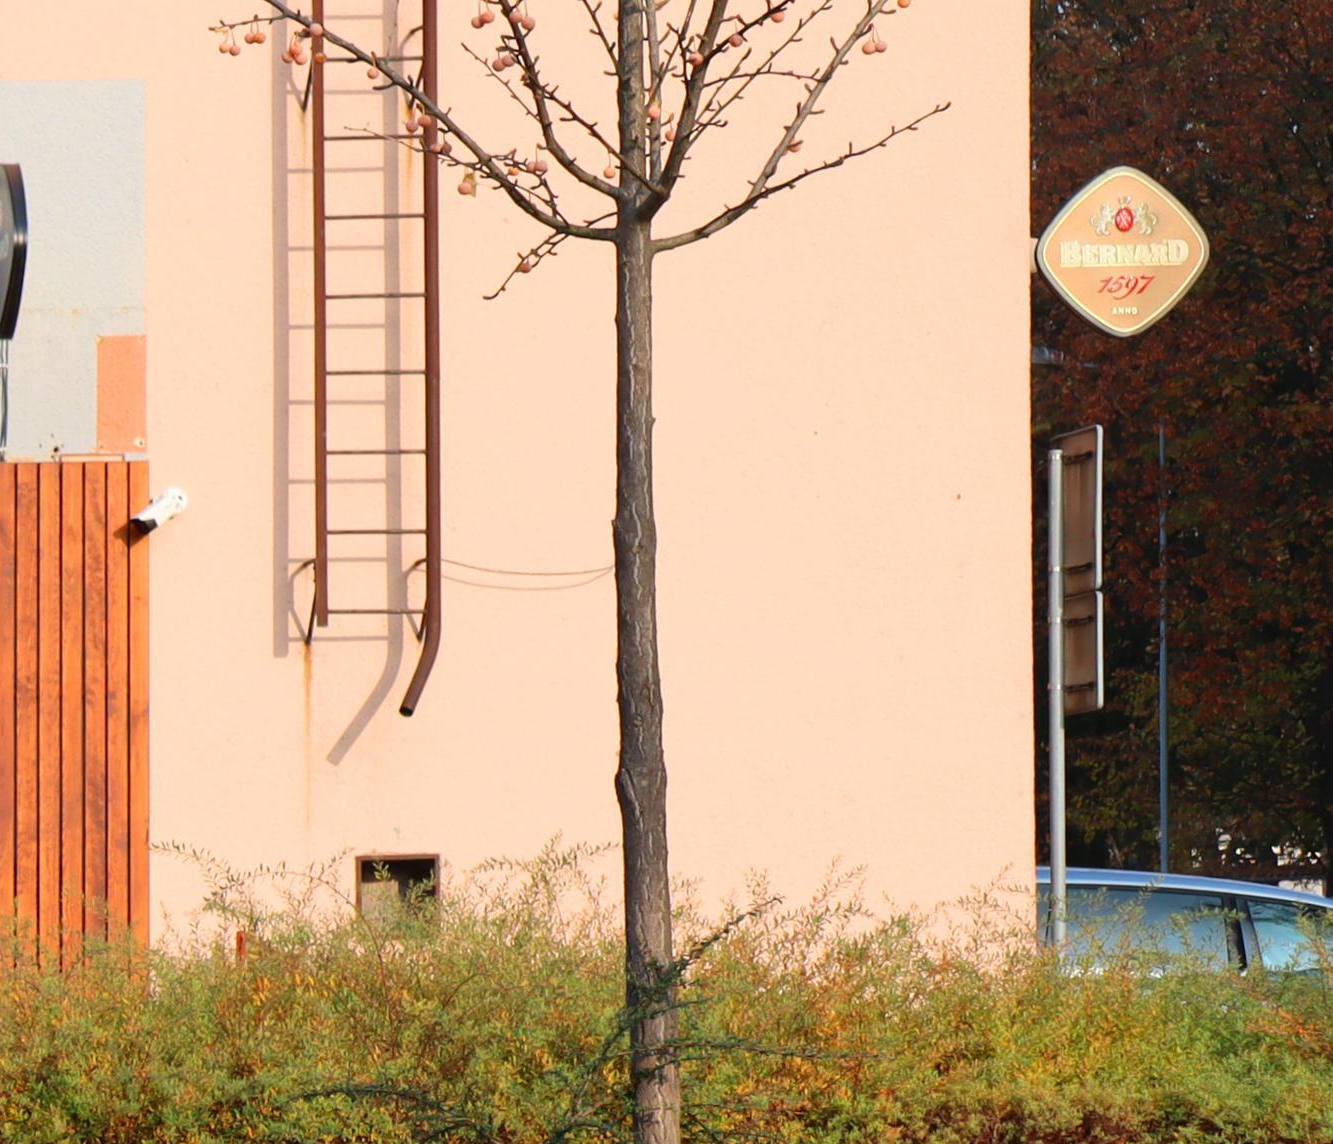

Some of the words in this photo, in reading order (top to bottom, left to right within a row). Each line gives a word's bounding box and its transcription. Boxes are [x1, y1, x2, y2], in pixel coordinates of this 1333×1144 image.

[1060, 239, 1189, 268] BERNARD
[1097, 275, 1154, 300] 1597
[1112, 305, 1138, 315] ANNO
